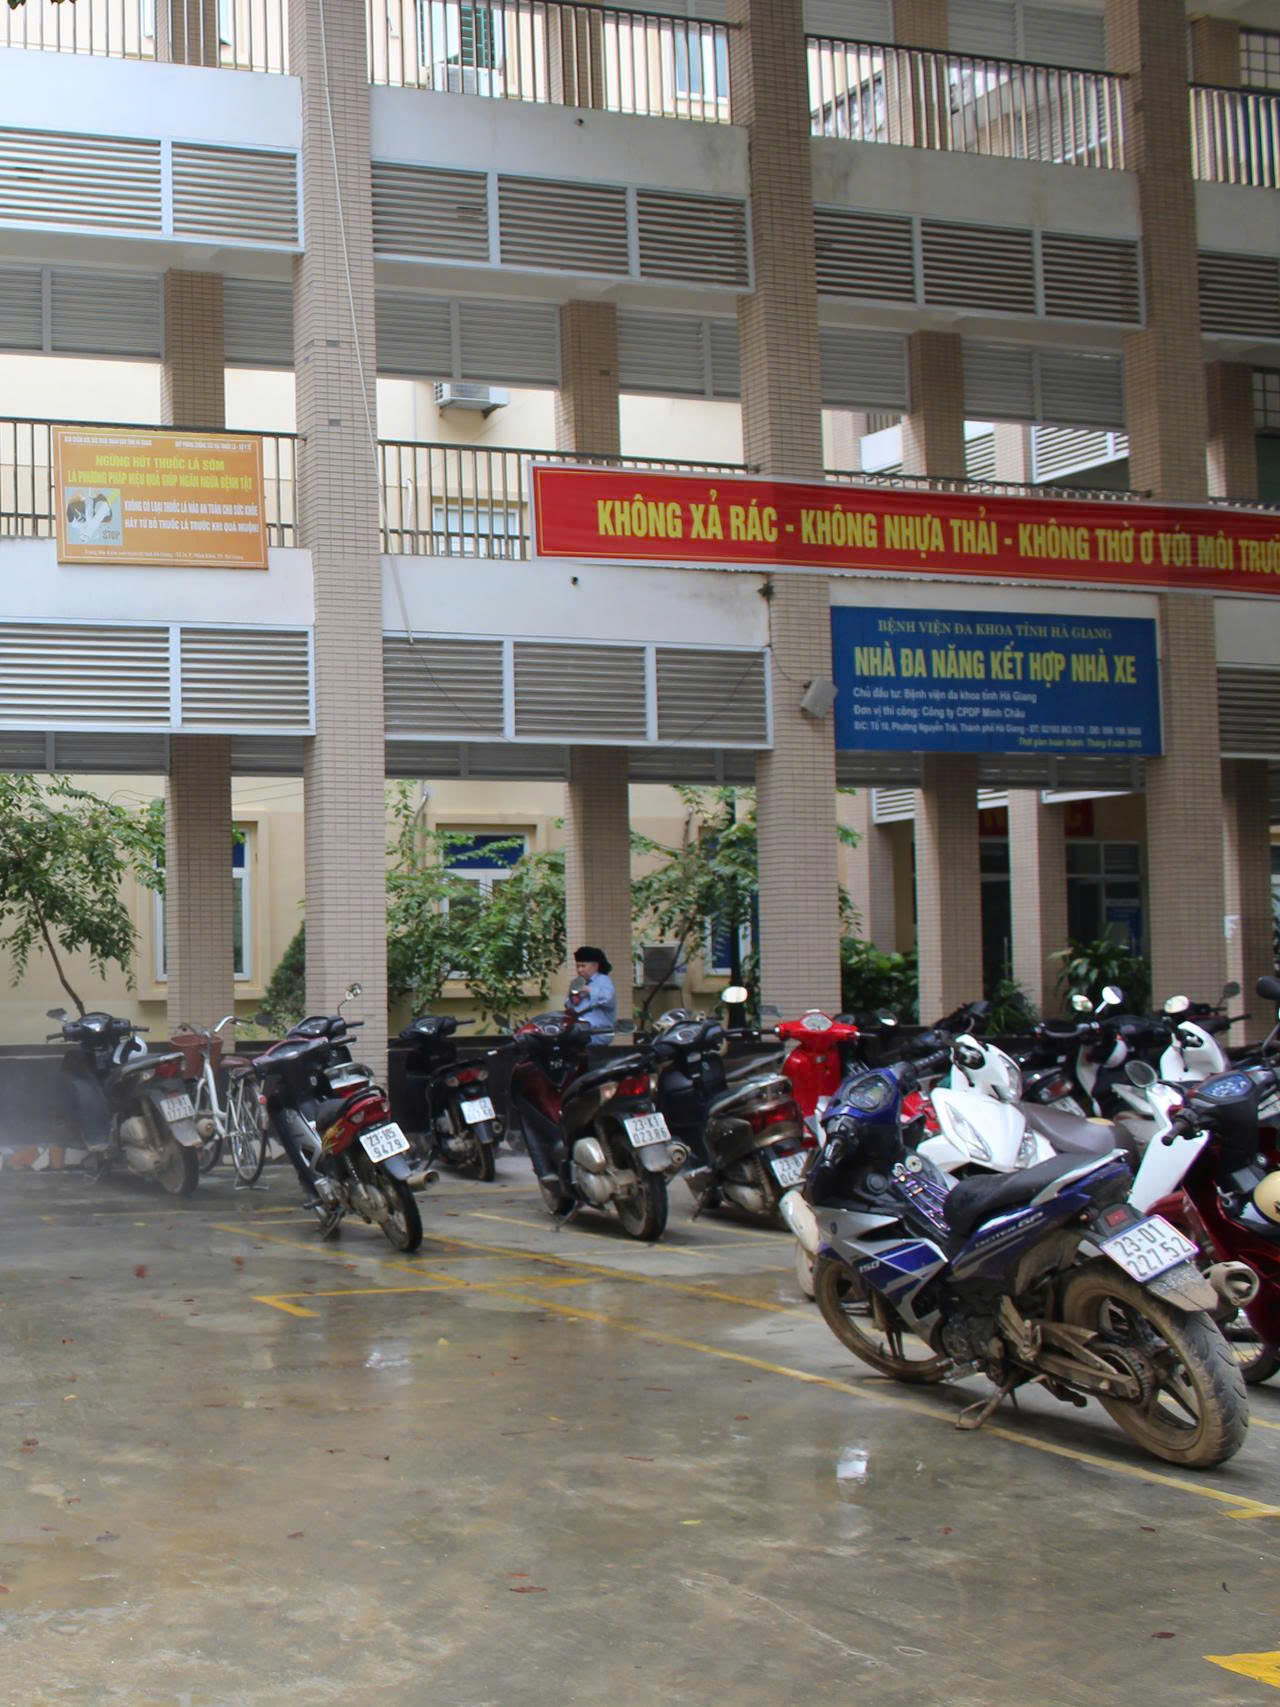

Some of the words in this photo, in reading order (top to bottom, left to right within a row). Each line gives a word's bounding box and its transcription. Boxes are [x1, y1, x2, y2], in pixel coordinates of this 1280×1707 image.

[597, 494, 682, 539] KHÔNG
[690, 488, 724, 541] XẢ
[730, 498, 779, 543] RÁC
[801, 504, 878, 548] KHÔNG
[885, 513, 945, 558] NHỰA
[950, 505, 998, 556] THẢI
[1019, 518, 1090, 560] KHÔNG
[1094, 520, 1136, 564] THỜ
[1159, 524, 1192, 567] VỚI
[1197, 530, 1234, 570] MÔI
[877, 619, 916, 635] BỆNH
[918, 620, 951, 637] VIỆN
[954, 623, 974, 635] ĐA
[976, 623, 1013, 636] KHOA
[1015, 620, 1048, 637] TỈNH
[1051, 622, 1069, 638] HÀ
[1071, 625, 1112, 640] GIANG
[854, 640, 896, 677] NHÀ
[901, 648, 927, 678] ĐA
[932, 643, 985, 679] NĂNG
[991, 640, 1025, 681] KẾT
[1029, 649, 1066, 688] HỢP
[1071, 648, 1109, 683] NHÀ
[1114, 655, 1137, 683] XE
[853, 686, 871, 698] Chủ
[873, 687, 888, 698] đầu
[904, 688, 927, 701] Bệnh
[928, 688, 946, 701] viện
[948, 690, 959, 700] đa
[960, 690, 980, 700] khoa
[982, 688, 997, 700] tỉnh
[1000, 690, 1011, 701] Hà
[1012, 691, 1037, 704] Giang
[883, 705, 895, 715] thi
[922, 706, 945, 718] Công
[946, 708, 954, 718] ty
[982, 707, 1003, 718] Minh
[1004, 707, 1025, 718] Châu
[858, 1260, 880, 1274] 150
[1126, 1236, 1191, 1277] 227.52
